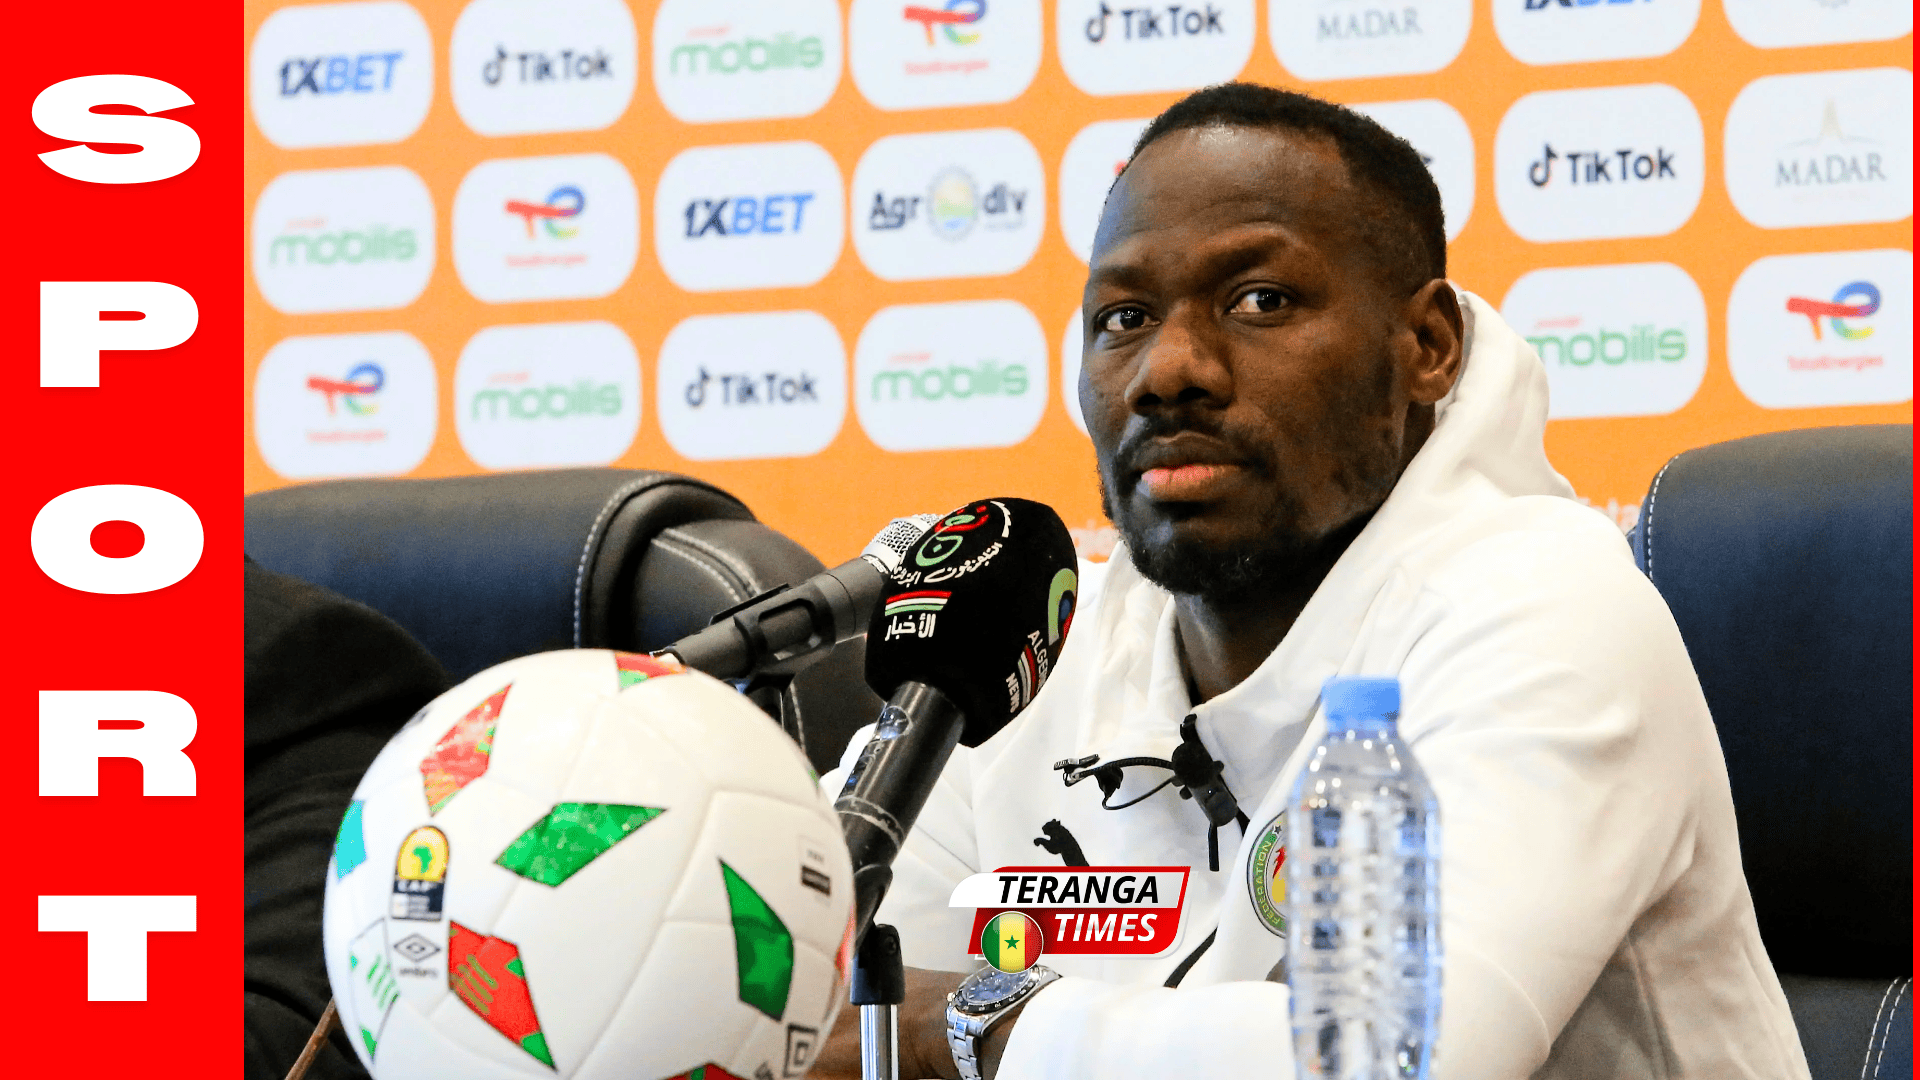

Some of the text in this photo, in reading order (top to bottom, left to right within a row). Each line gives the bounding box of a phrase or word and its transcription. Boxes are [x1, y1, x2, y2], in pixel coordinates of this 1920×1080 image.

[1122, 6, 1224, 40] TikTok
[1317, 6, 1424, 41] MADAR
[279, 51, 405, 97] 1XBET
[517, 49, 614, 83] TikTok
[1567, 146, 1677, 186] TikTok
[1775, 152, 1888, 189] MADAR
[684, 192, 815, 239] 1XBET
[719, 371, 819, 406] TikTok
[884, 612, 937, 641] الأخبار
